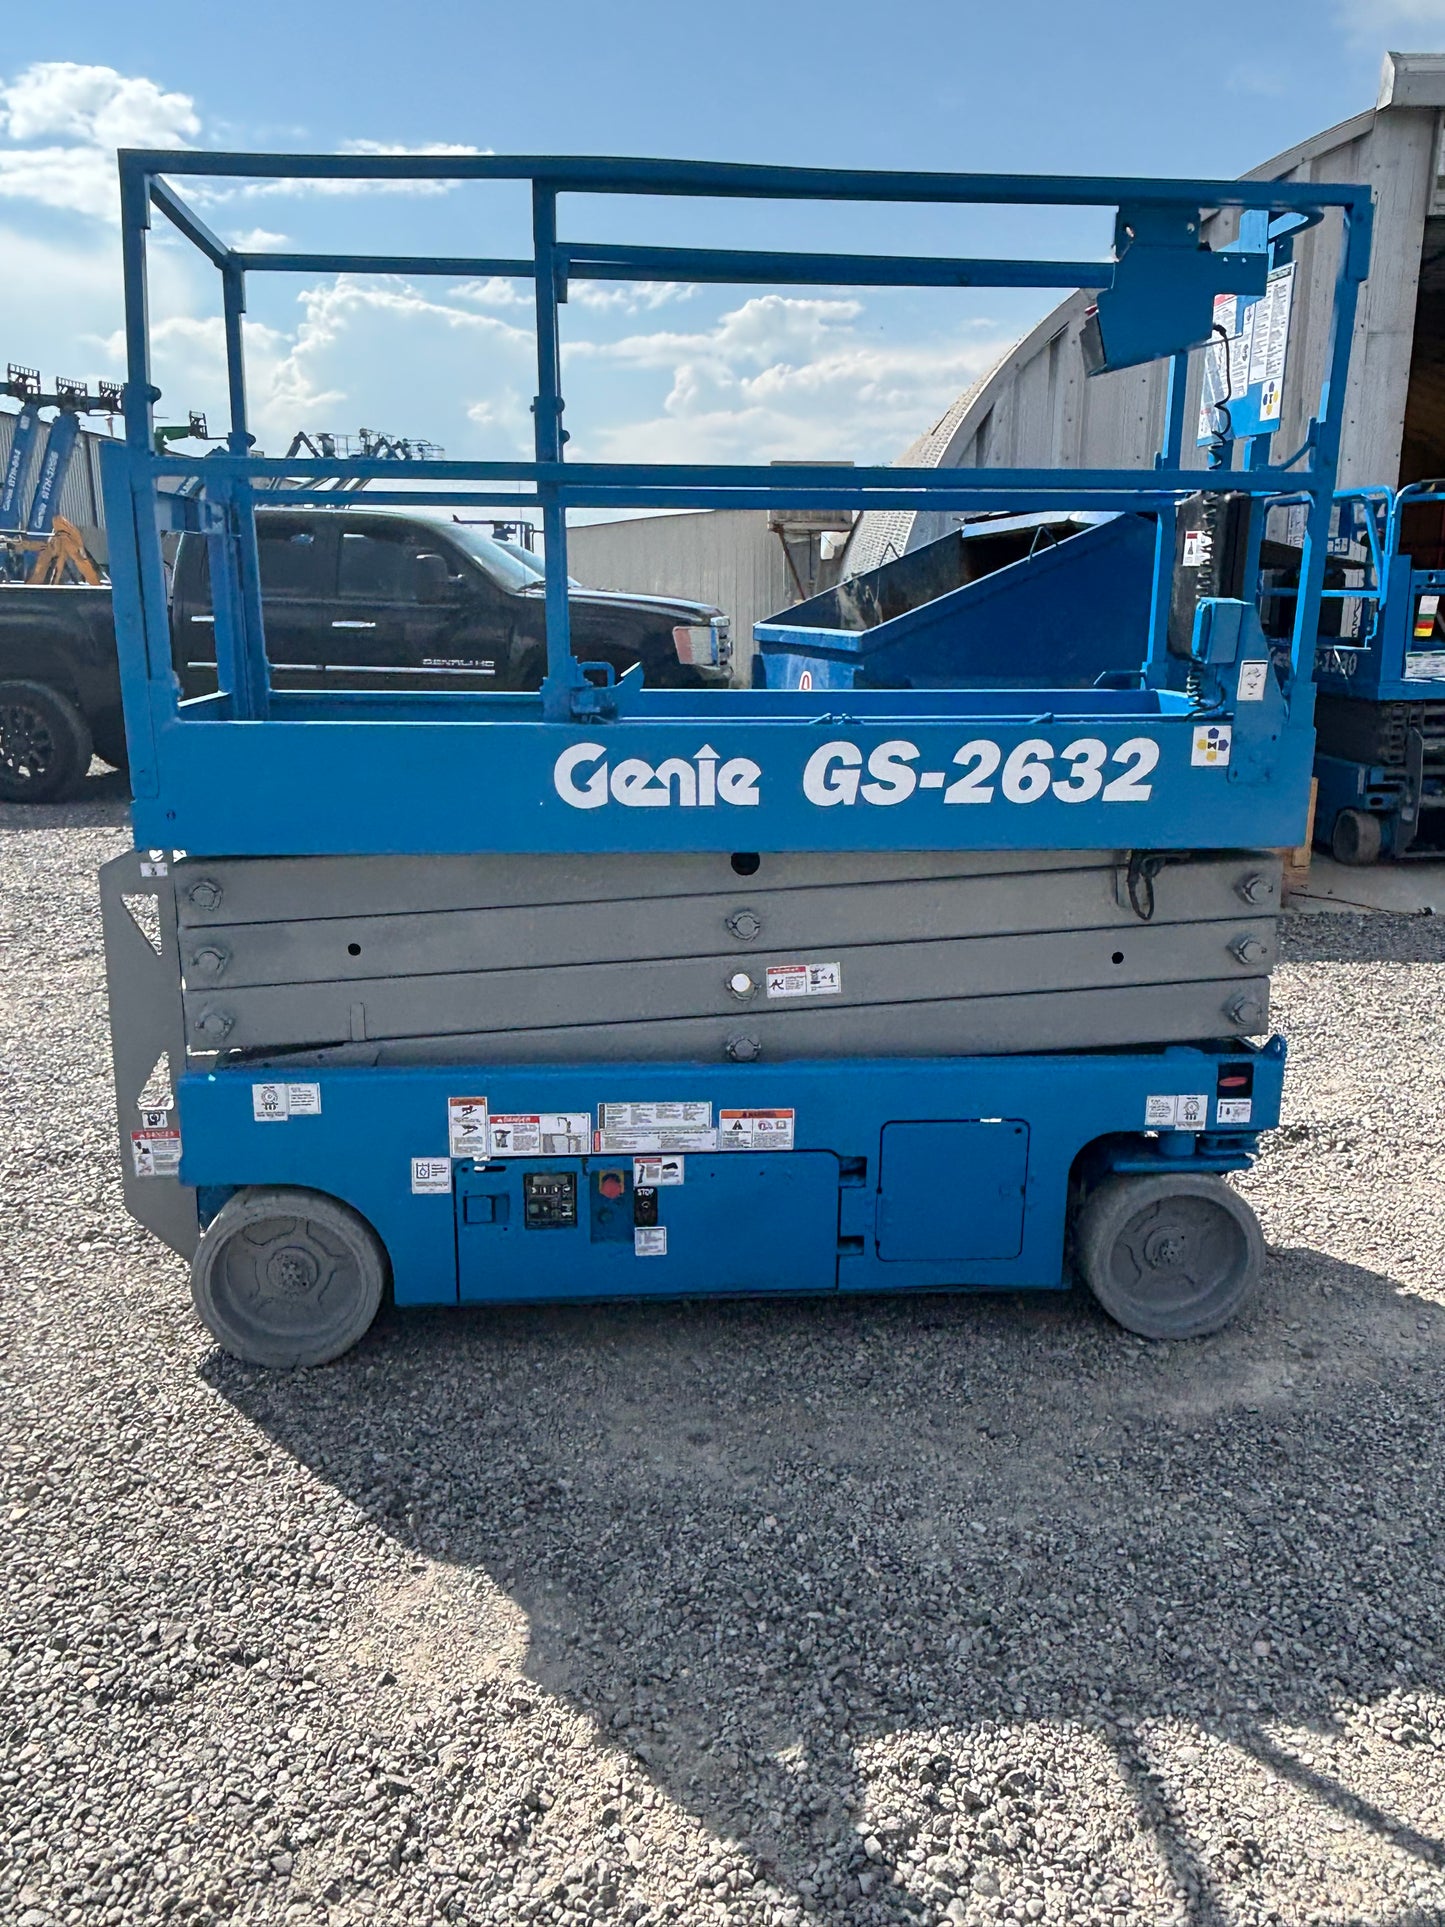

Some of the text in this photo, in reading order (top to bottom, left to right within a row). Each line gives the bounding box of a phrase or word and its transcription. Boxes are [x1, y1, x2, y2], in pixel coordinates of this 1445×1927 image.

[553, 737, 1161, 809] Genie GS-2632
[637, 1188, 654, 1196] STOP
